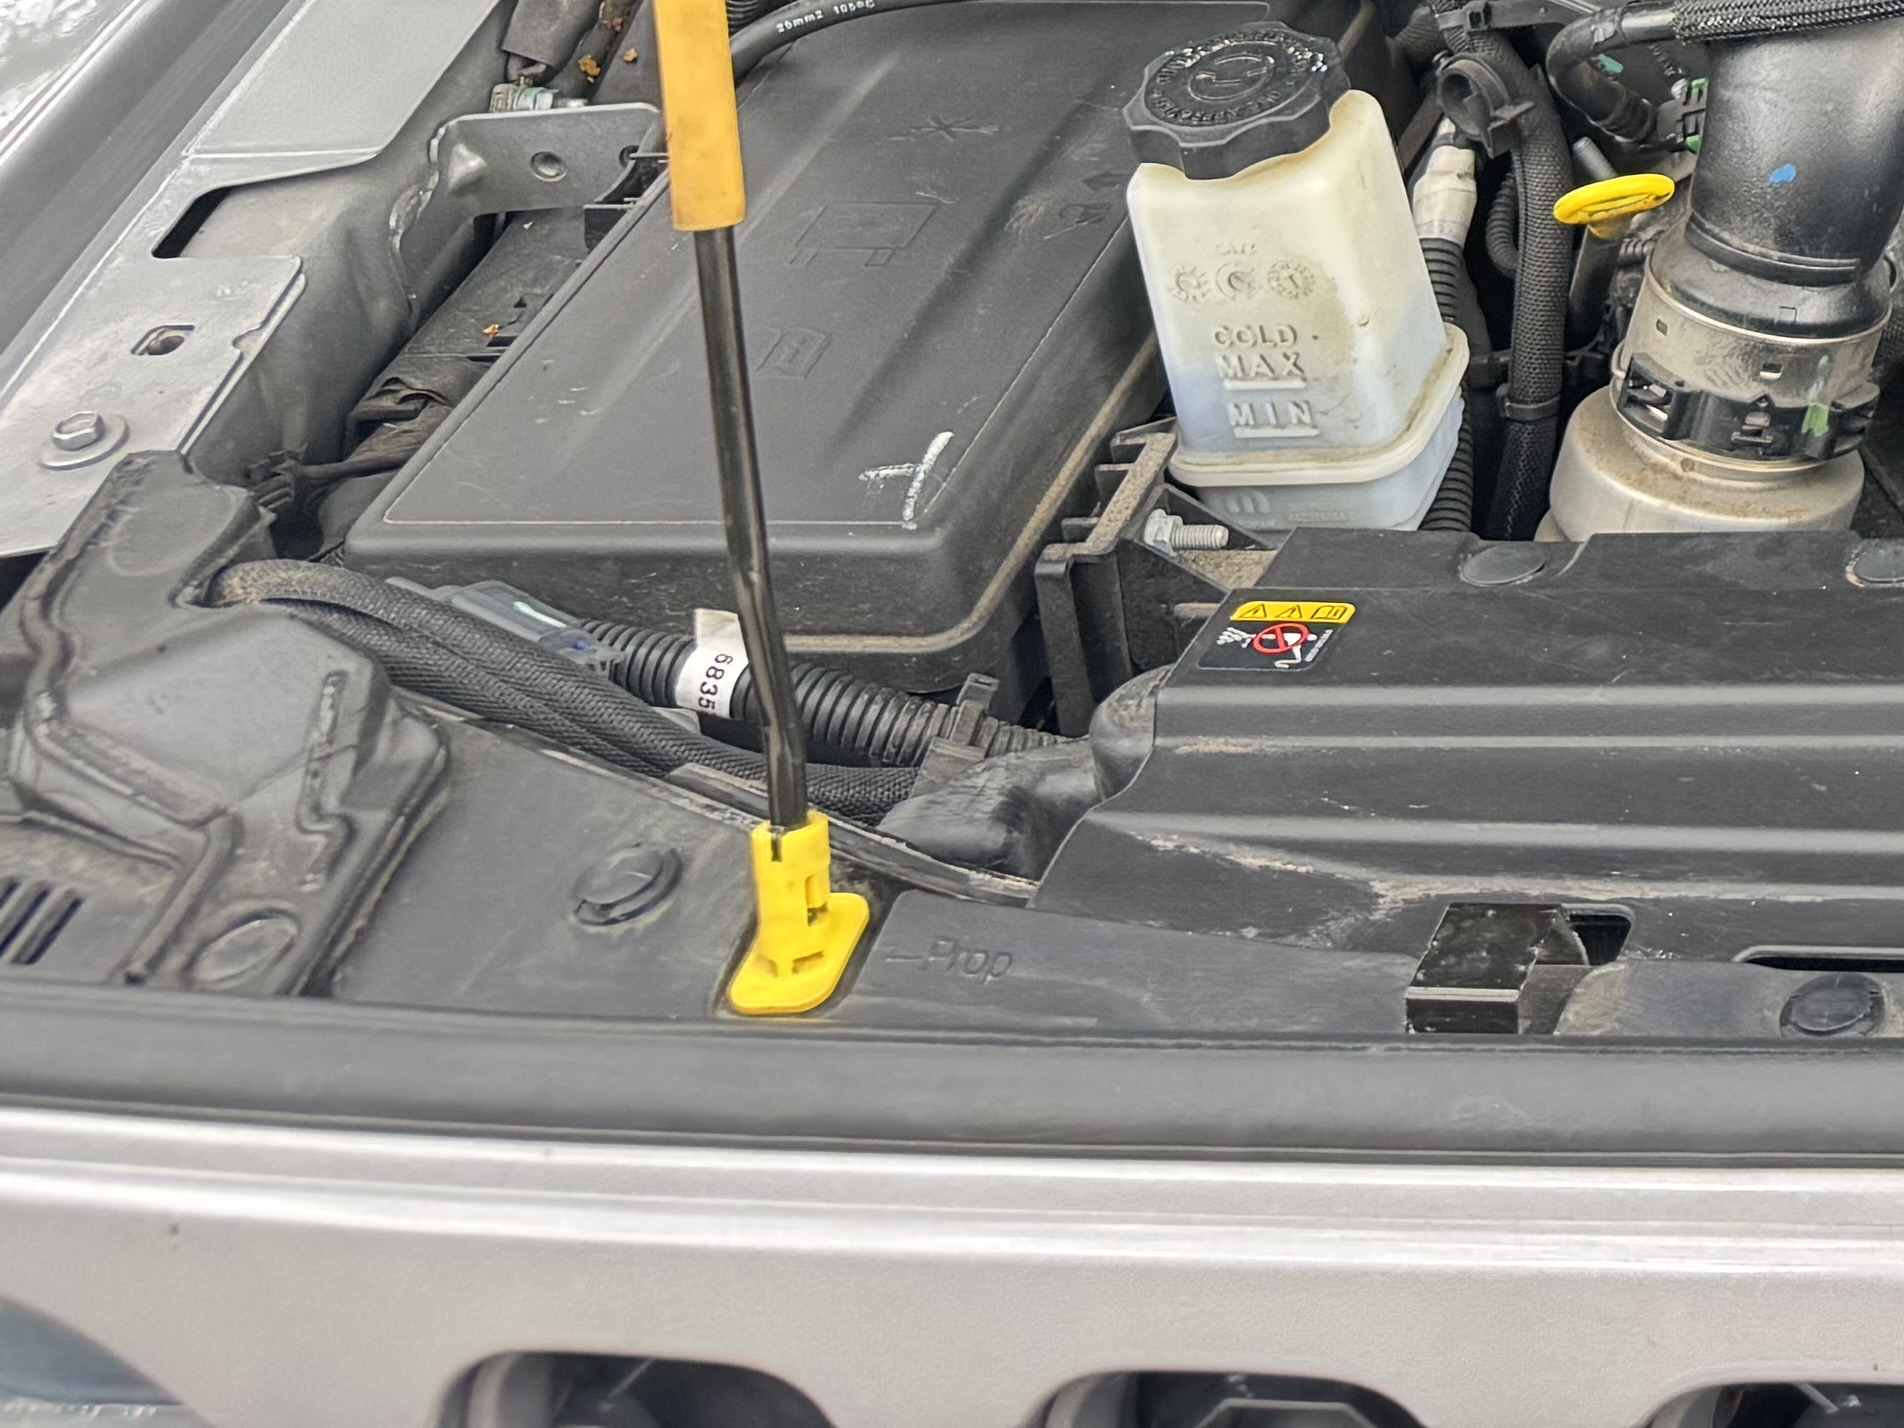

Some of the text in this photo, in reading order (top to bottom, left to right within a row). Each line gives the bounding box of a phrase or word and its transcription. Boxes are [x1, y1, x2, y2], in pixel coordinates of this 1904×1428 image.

[1214, 324, 1299, 348] COLD
[1216, 352, 1307, 380] MAX
[1226, 399, 1316, 428] MIN
[698, 653, 734, 714] 6835
